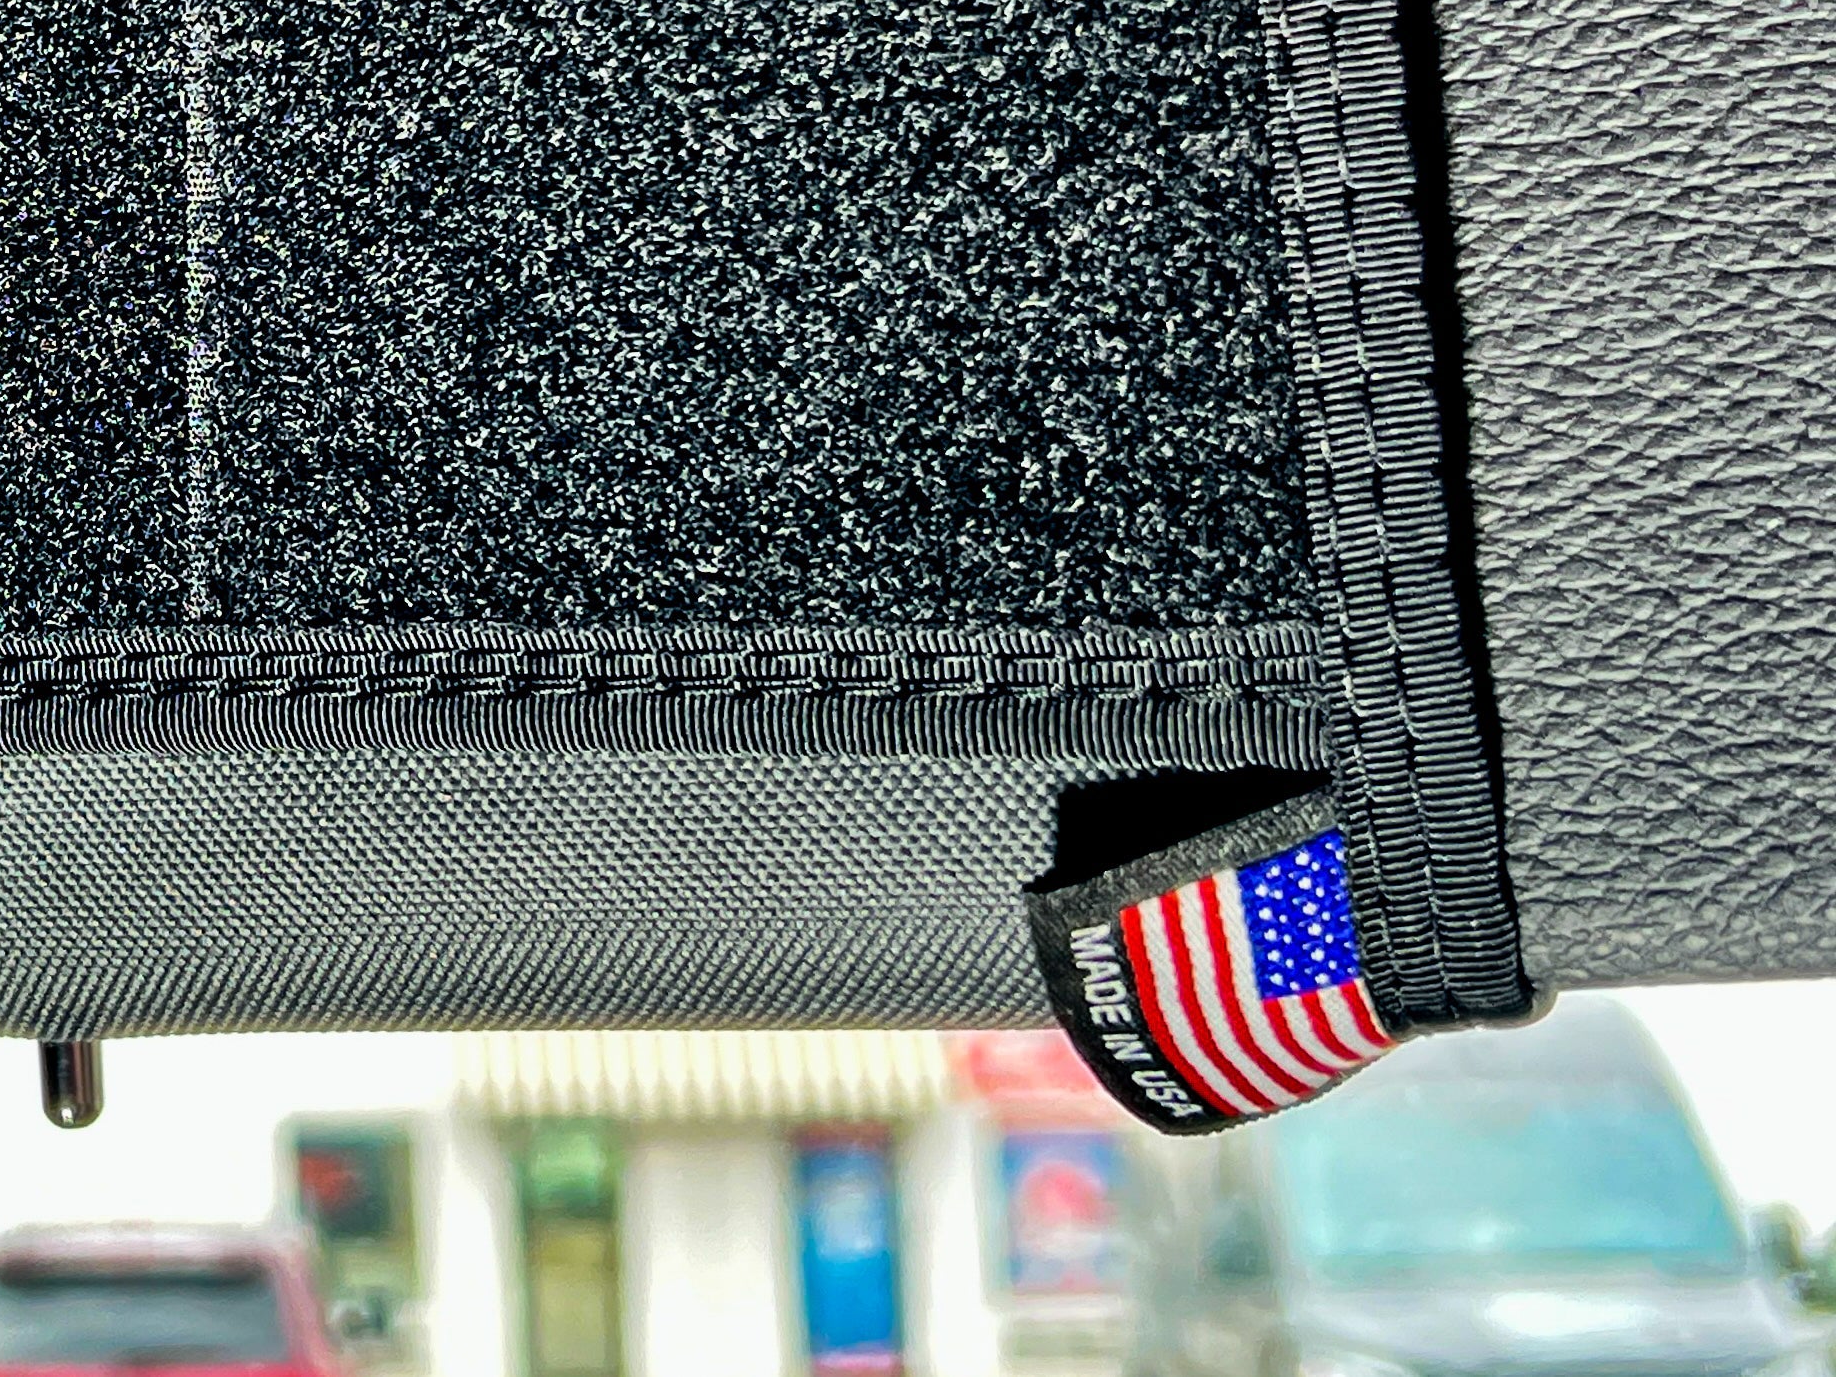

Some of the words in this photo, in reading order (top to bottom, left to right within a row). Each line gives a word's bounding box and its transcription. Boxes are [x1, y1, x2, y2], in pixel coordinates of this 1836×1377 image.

[1070, 923, 1132, 1026] MADE
[1102, 1033, 1153, 1062] IN
[1131, 1070, 1204, 1118] USA
